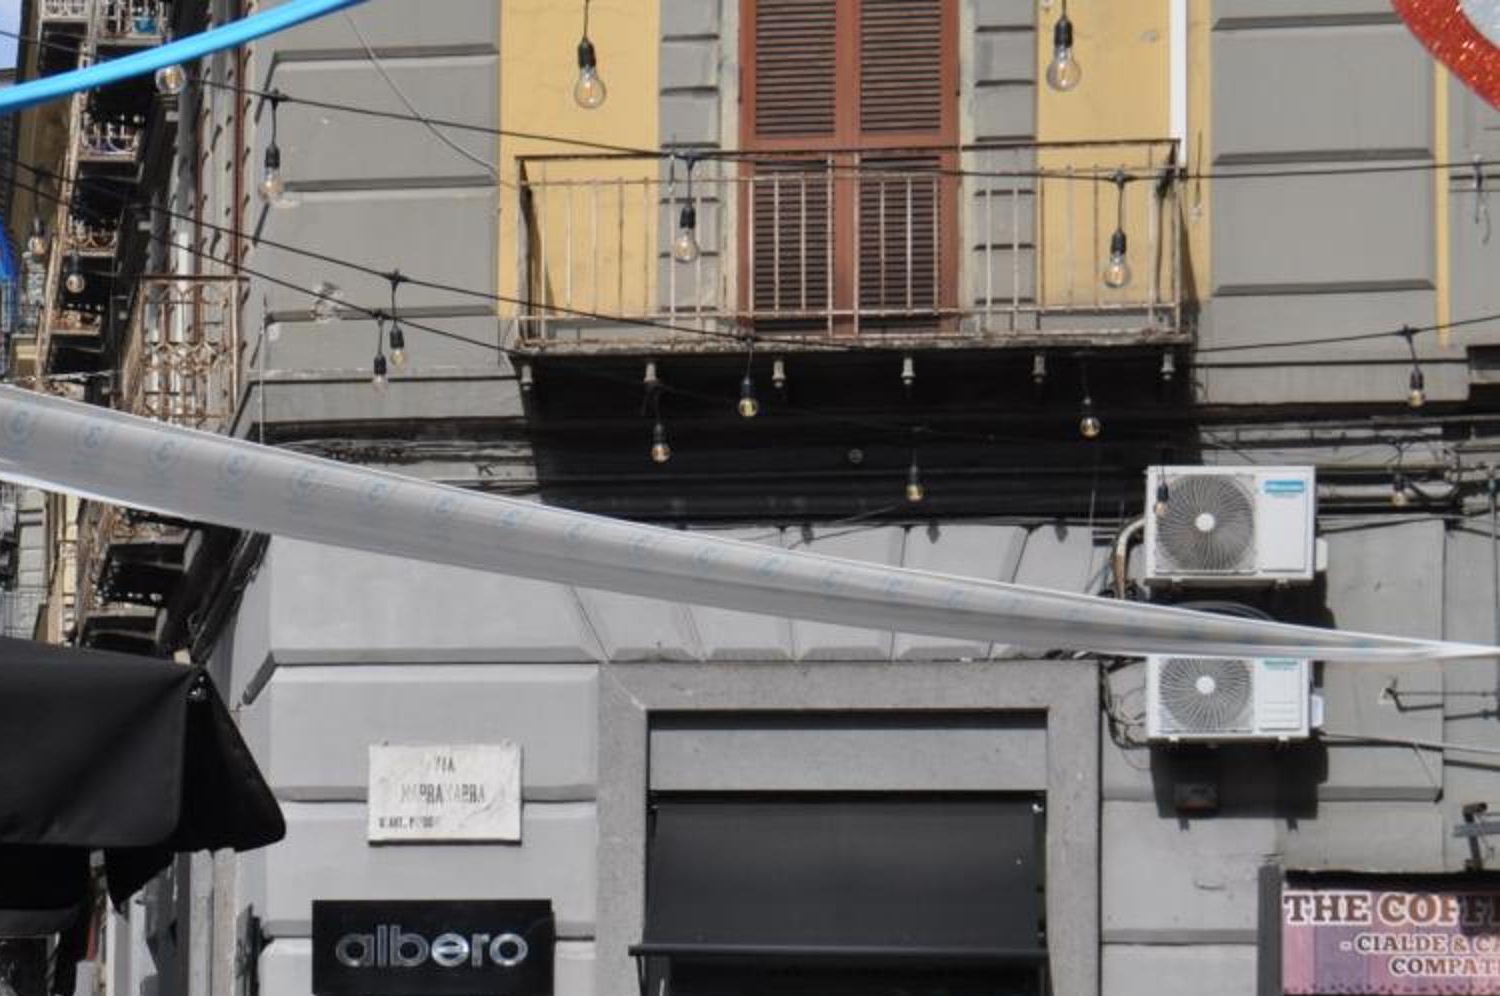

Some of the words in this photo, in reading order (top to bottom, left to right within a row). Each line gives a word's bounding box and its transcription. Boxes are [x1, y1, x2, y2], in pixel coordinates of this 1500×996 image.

[1285, 894, 1369, 922] THE
[335, 924, 528, 967] albero
[1357, 935, 1446, 951] CIALDE
[1454, 935, 1467, 951] &
